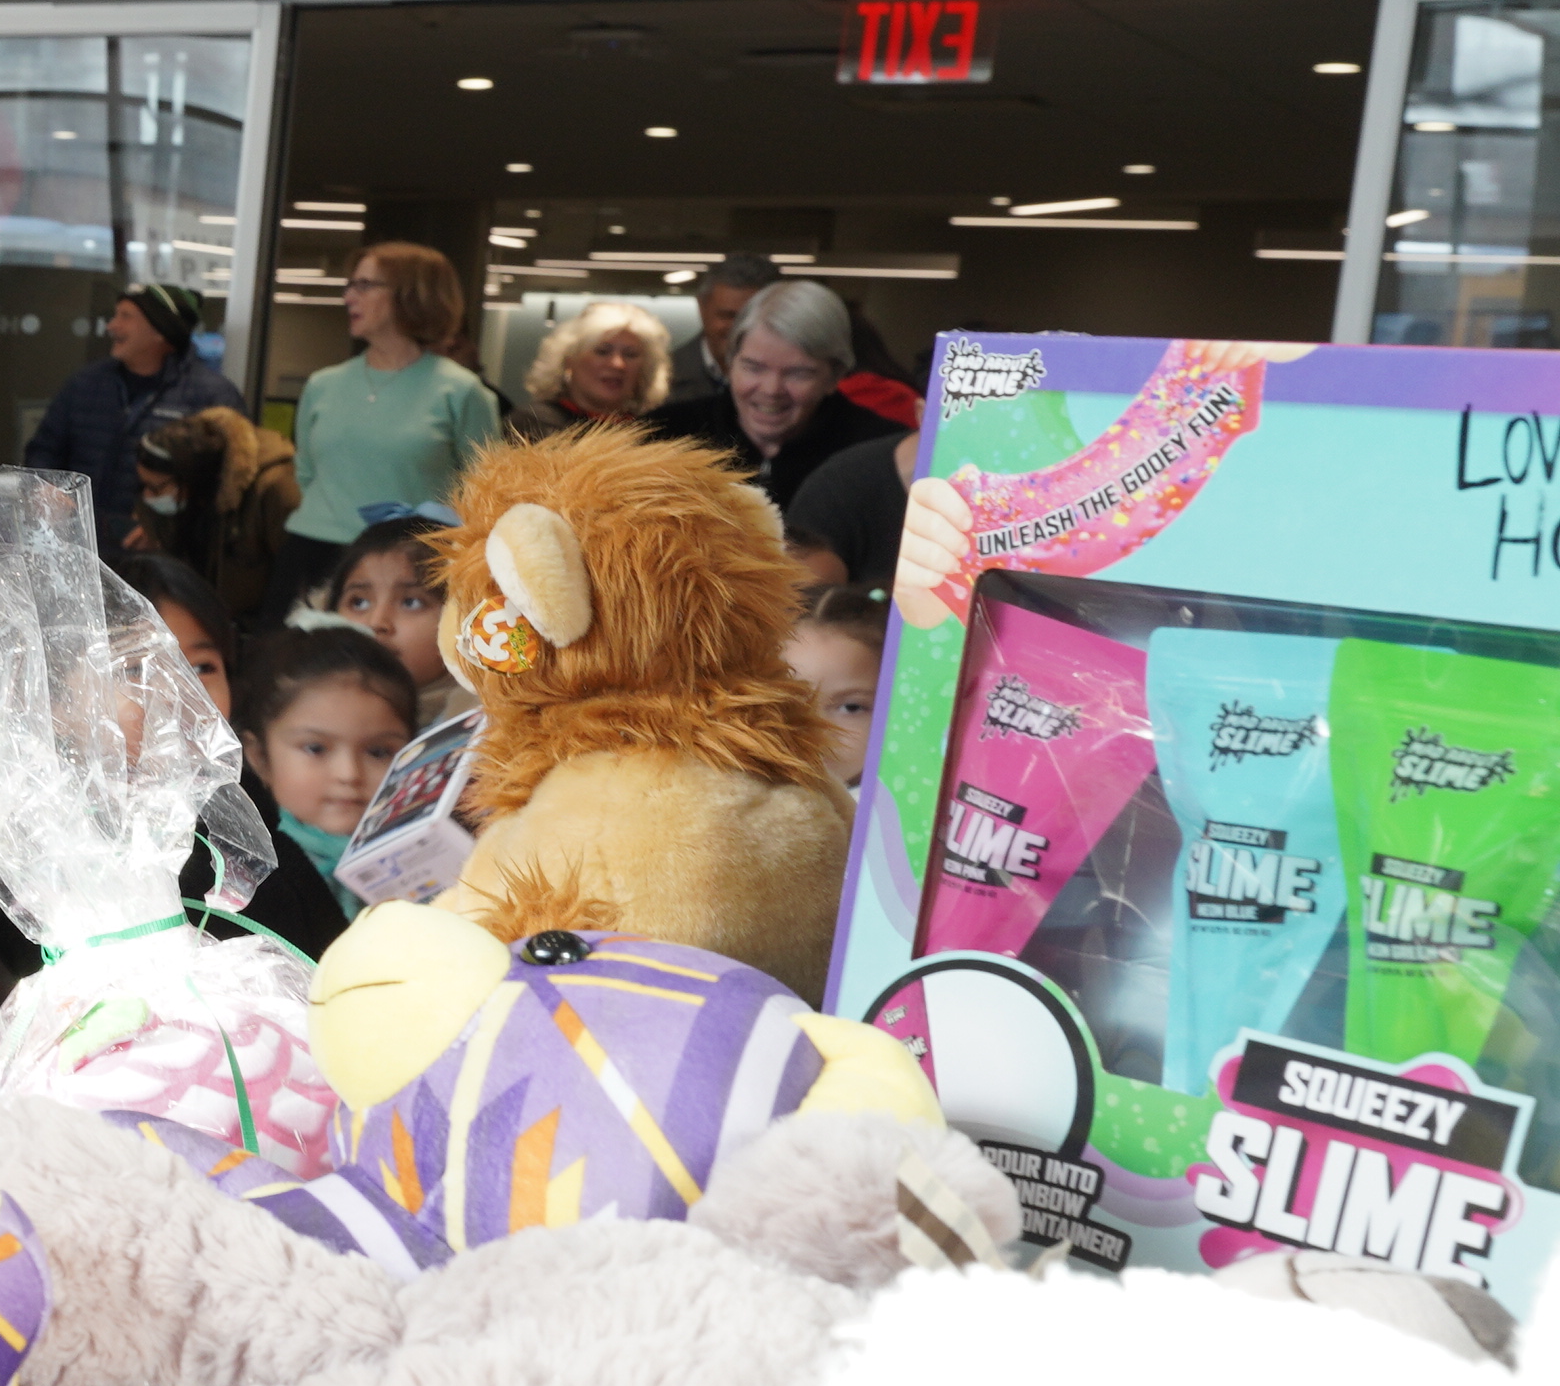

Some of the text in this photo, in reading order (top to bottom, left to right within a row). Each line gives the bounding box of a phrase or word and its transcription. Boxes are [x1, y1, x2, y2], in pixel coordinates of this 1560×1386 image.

[946, 368, 1024, 396] SLIME
[952, 354, 1032, 373] MAD ABOUT
[978, 385, 1237, 556] UNLEASH THE GOOEY FUN!
[473, 598, 522, 661] ty
[988, 698, 1060, 738] SLIME
[1214, 727, 1300, 754] SLIME
[1395, 754, 1490, 791] SLIME
[1278, 1060, 1468, 1146] SQUEEZY
[1044, 1158, 1099, 1195] INTO
[1194, 1111, 1508, 1289] SLIME
[1022, 1209, 1126, 1262] ONTAINER!
